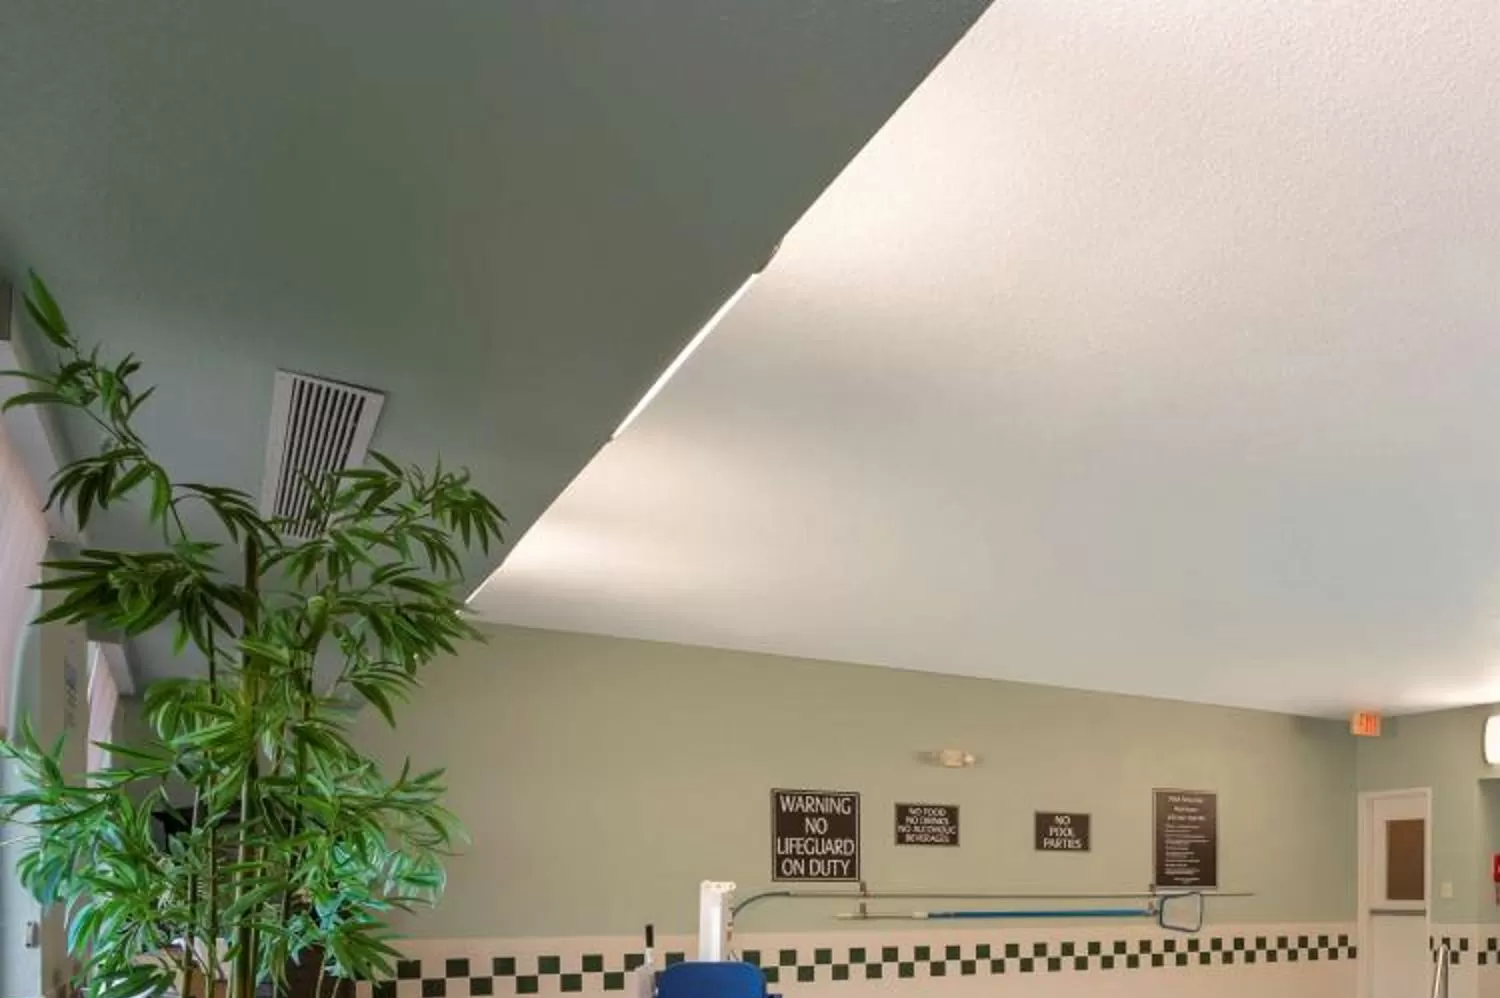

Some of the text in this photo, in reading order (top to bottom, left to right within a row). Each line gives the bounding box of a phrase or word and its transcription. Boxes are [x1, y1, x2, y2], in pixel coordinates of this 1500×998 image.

[780, 795, 851, 815] WARNING
[908, 807, 923, 816] NO
[805, 817, 828, 835] NO
[905, 815, 919, 825] NO
[1055, 815, 1071, 825] NO
[777, 836, 855, 856] LIFEGUARD
[1043, 837, 1082, 849] PARTIES
[781, 858, 851, 876] ON DUTY
